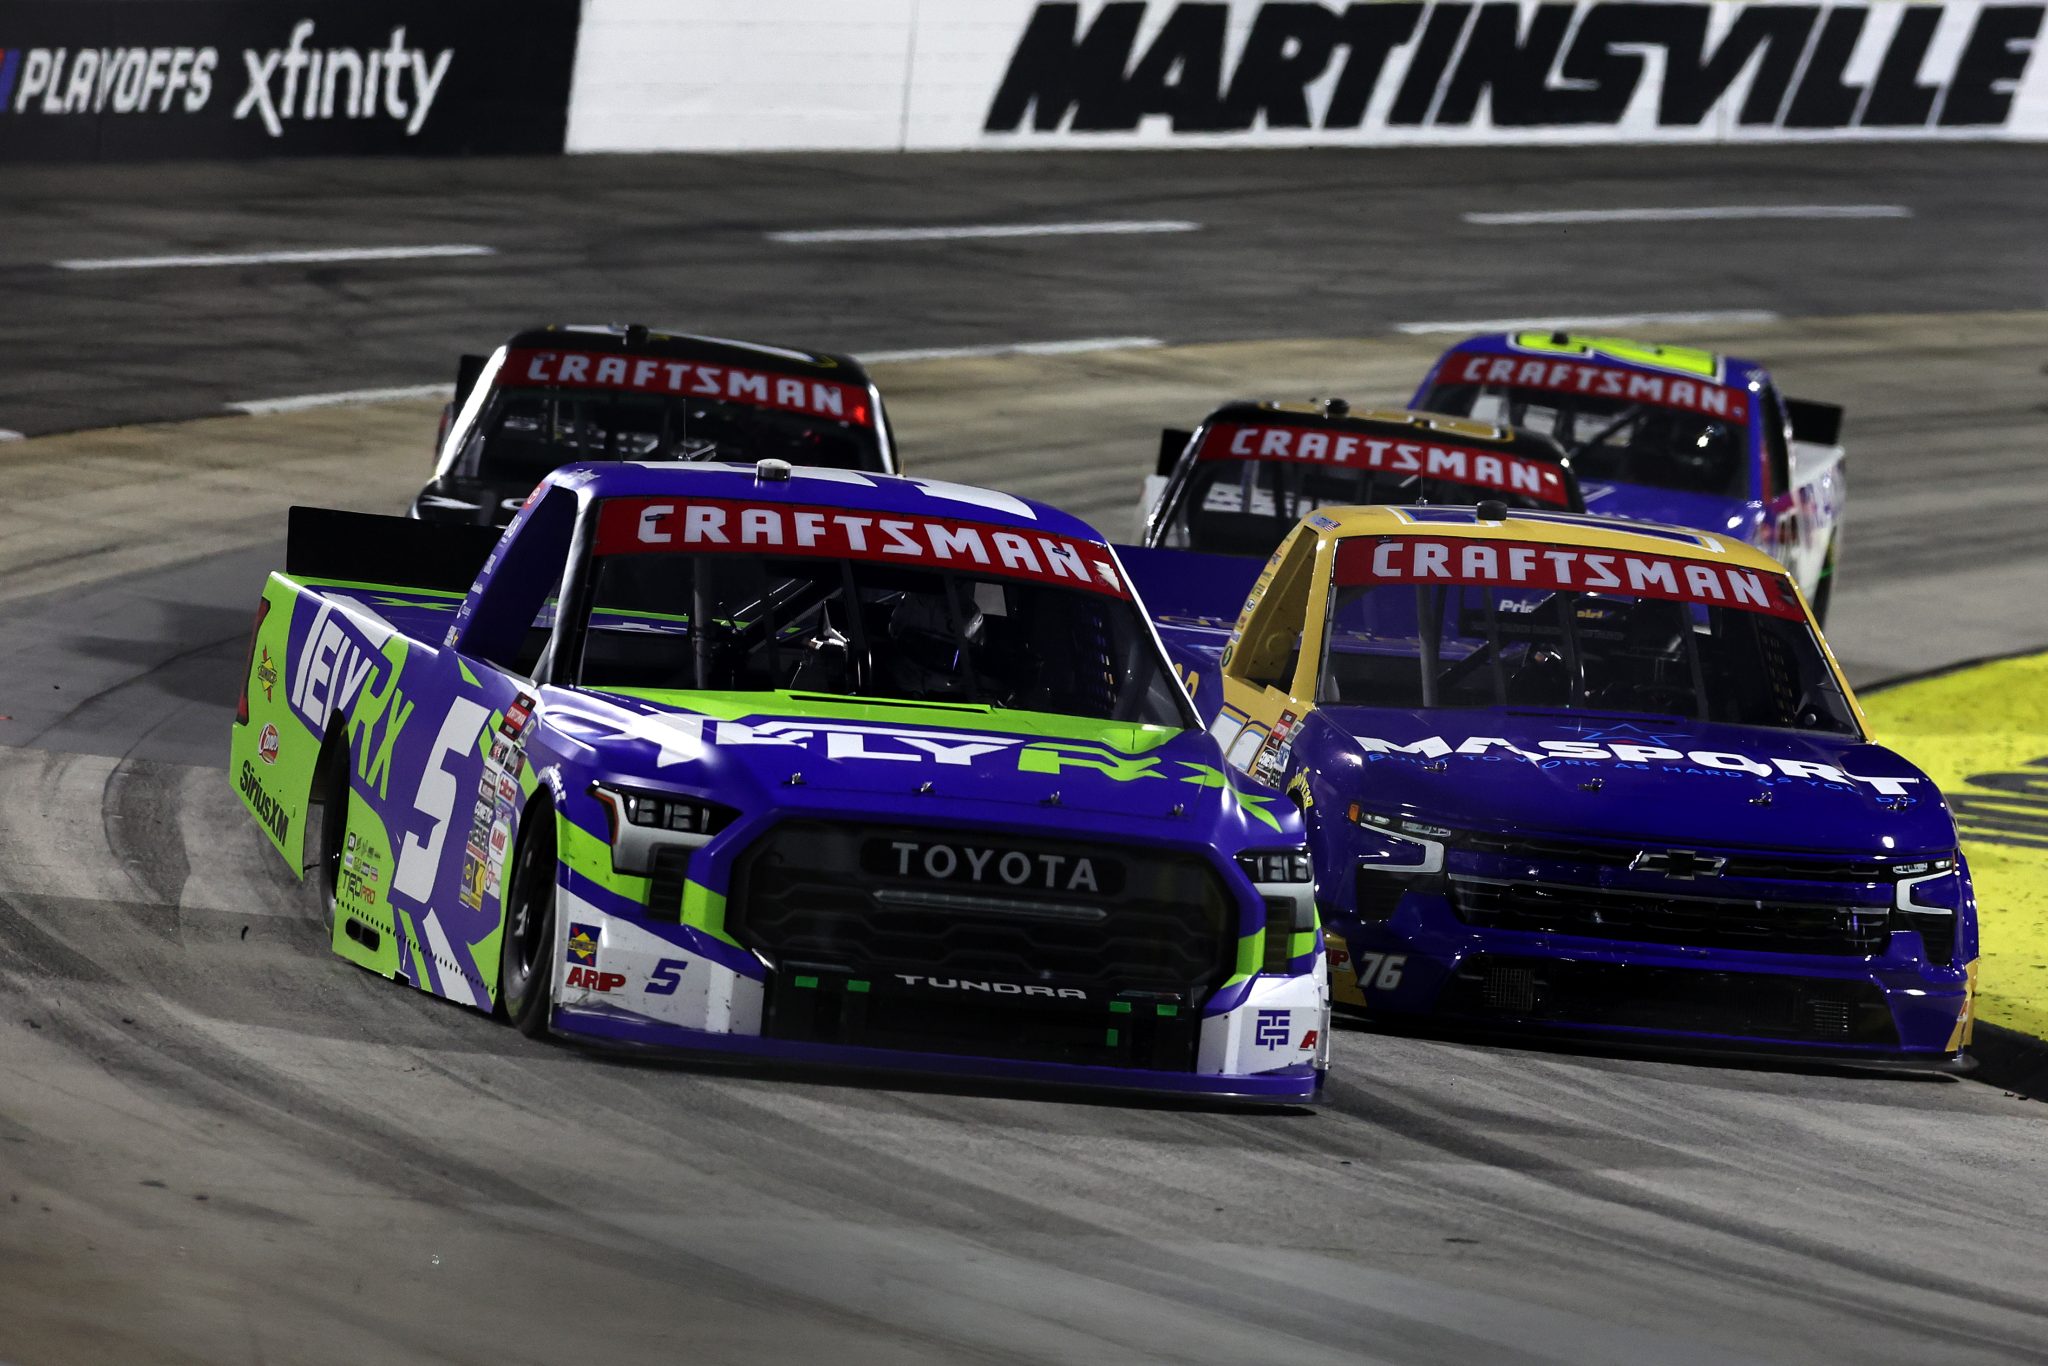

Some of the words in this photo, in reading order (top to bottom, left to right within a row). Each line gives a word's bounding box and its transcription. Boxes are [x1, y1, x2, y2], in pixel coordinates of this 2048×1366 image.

[15, 47, 219, 114] PLAYOFFS
[233, 19, 455, 137] xfinity
[982, 0, 2048, 134] MARTINSVILLE
[526, 352, 845, 416] CRAFTSMAN
[1463, 356, 1730, 415] CRAFTSMAN
[1230, 427, 1541, 493] CRAFTSMAN
[637, 504, 1094, 584] CRAFTSMAN
[1371, 542, 1771, 609] CRAFTSMAN
[1352, 735, 1921, 796] MASPORT
[1662, 766, 1744, 778] HARD
[239, 759, 290, 848] SiriusXM
[393, 695, 491, 905] 5
[892, 841, 1099, 891] TOYOTA
[566, 965, 627, 993] ARP
[644, 958, 688, 996] 5
[895, 974, 1087, 1000] TUNDRA
[1358, 951, 1408, 990] 76
